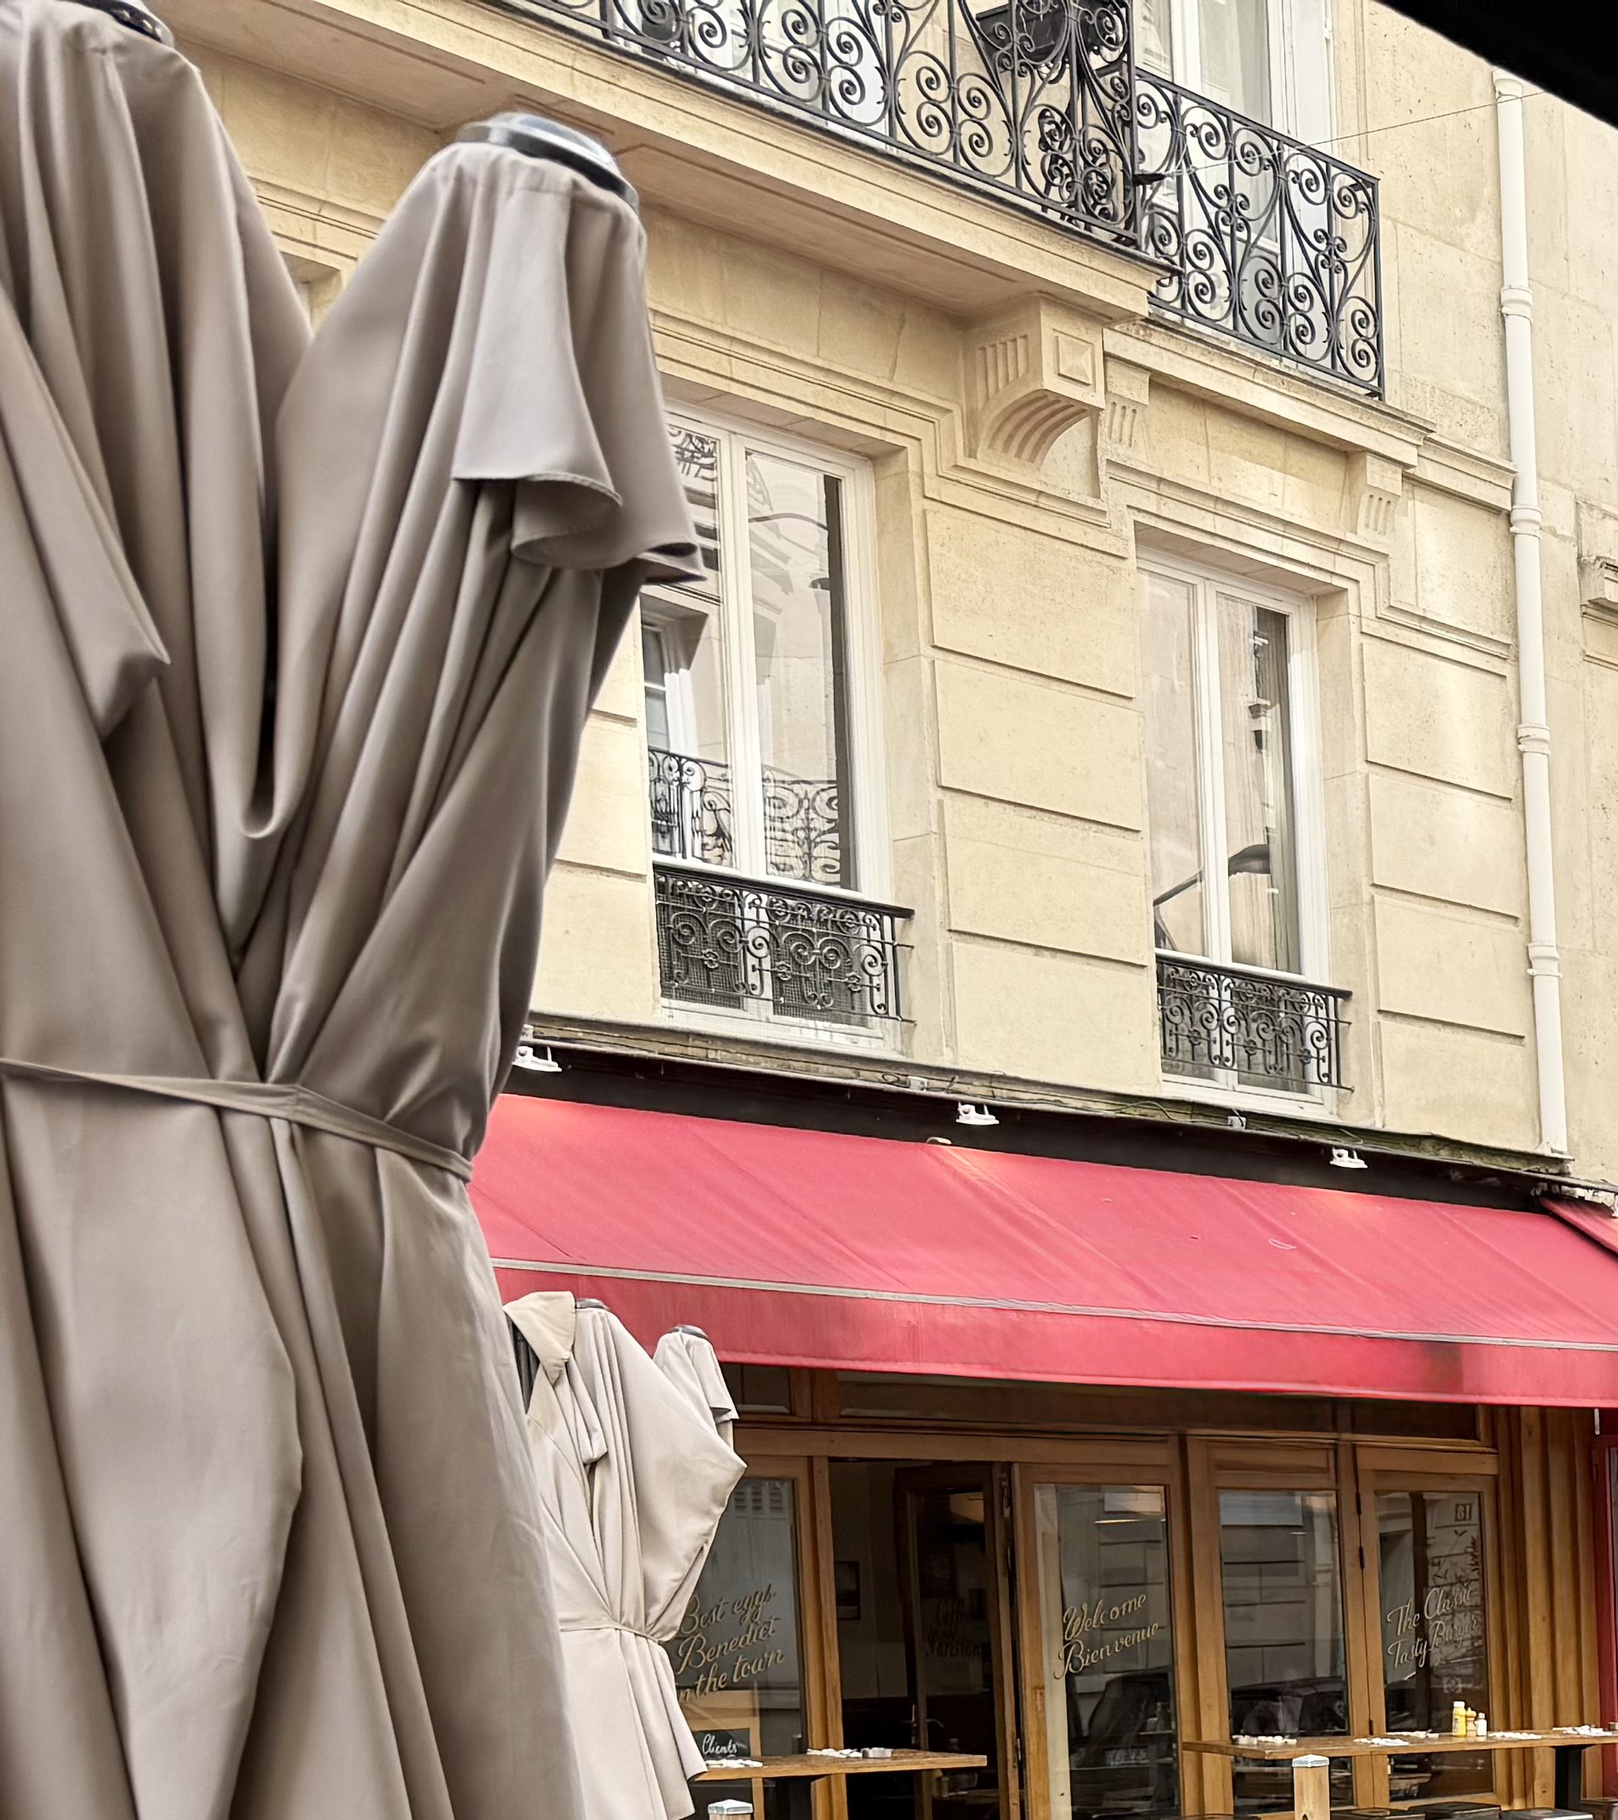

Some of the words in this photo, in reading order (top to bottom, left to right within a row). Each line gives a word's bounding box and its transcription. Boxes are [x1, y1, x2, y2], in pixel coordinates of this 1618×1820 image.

[679, 1593, 726, 1634] Best
[1063, 1594, 1147, 1641] Welcome
[1386, 1598, 1420, 1635] The
[1424, 1583, 1474, 1620] Classic
[676, 1617, 780, 1675] Benedict
[1053, 1623, 1159, 1680] Bienvenue
[1387, 1636, 1428, 1669] Tasty
[693, 1662, 728, 1698] the
[732, 1649, 785, 1684] town
